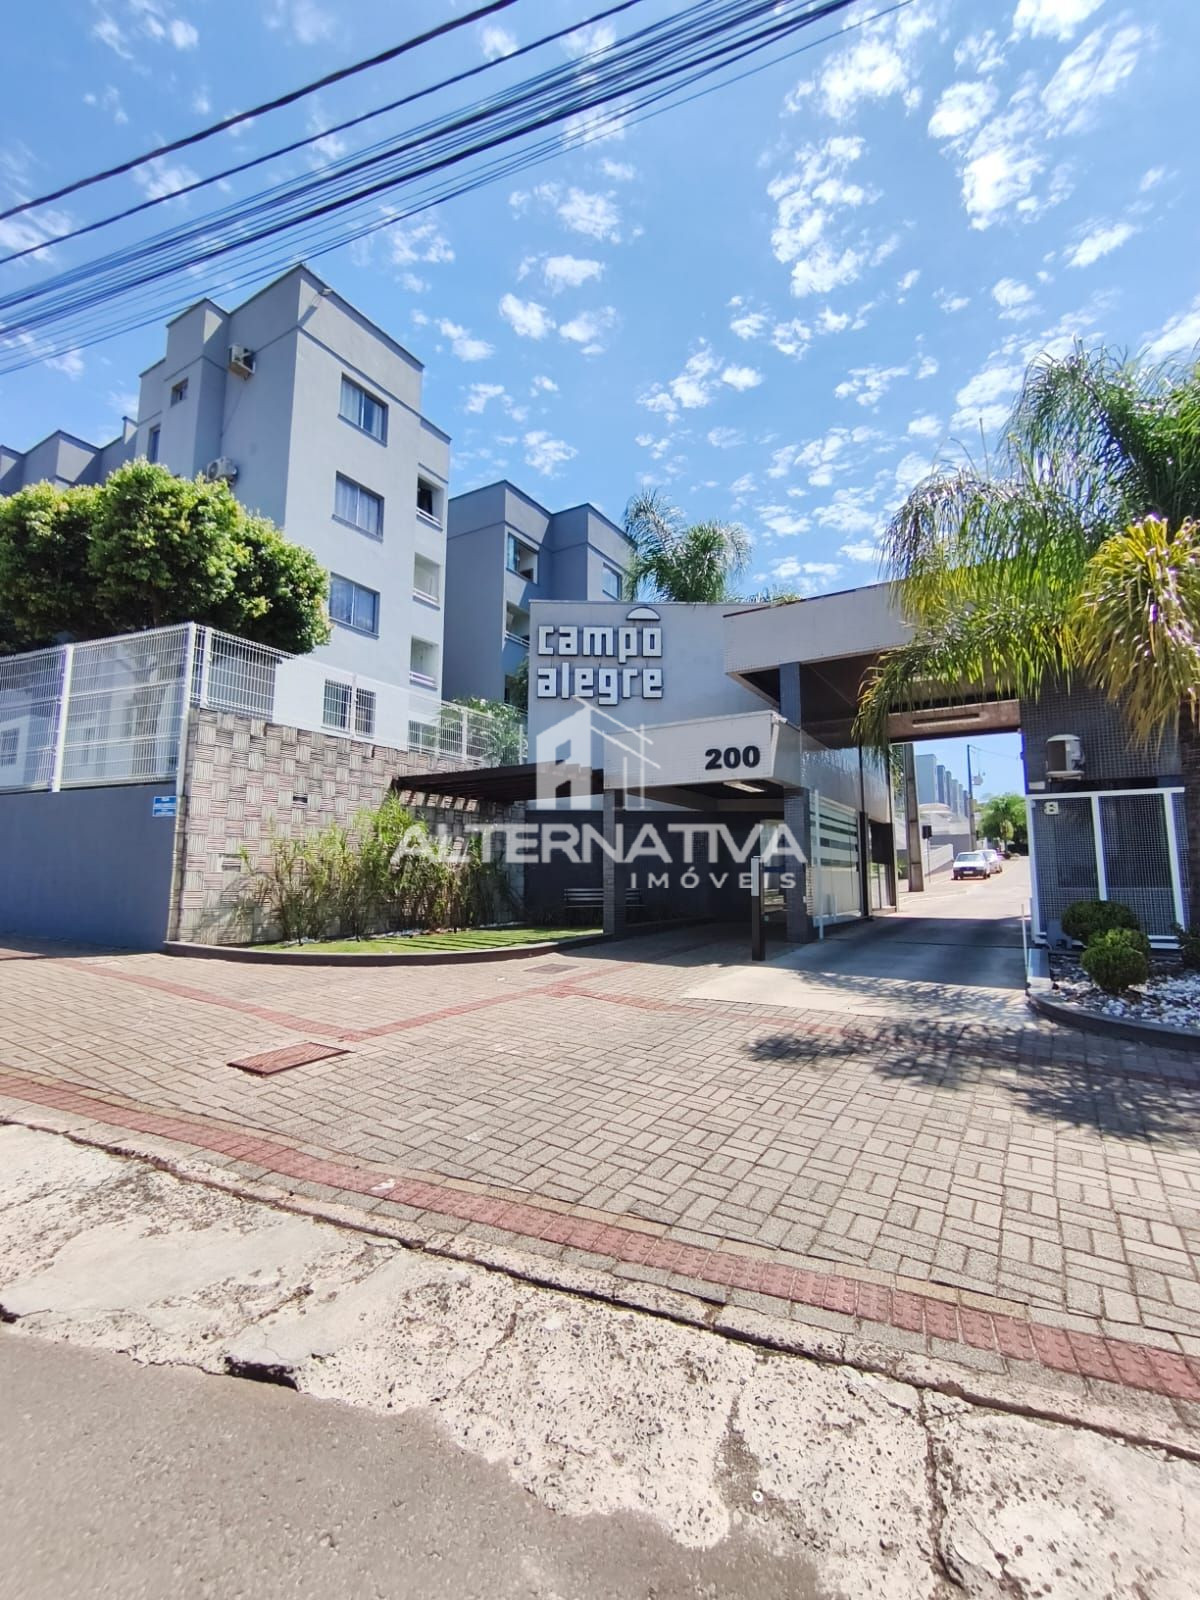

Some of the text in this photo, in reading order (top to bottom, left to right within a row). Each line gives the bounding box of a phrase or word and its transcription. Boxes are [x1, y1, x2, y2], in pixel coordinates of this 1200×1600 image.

[537, 624, 664, 664] campo
[536, 662, 664, 706] alegre
[704, 745, 761, 770] 200
